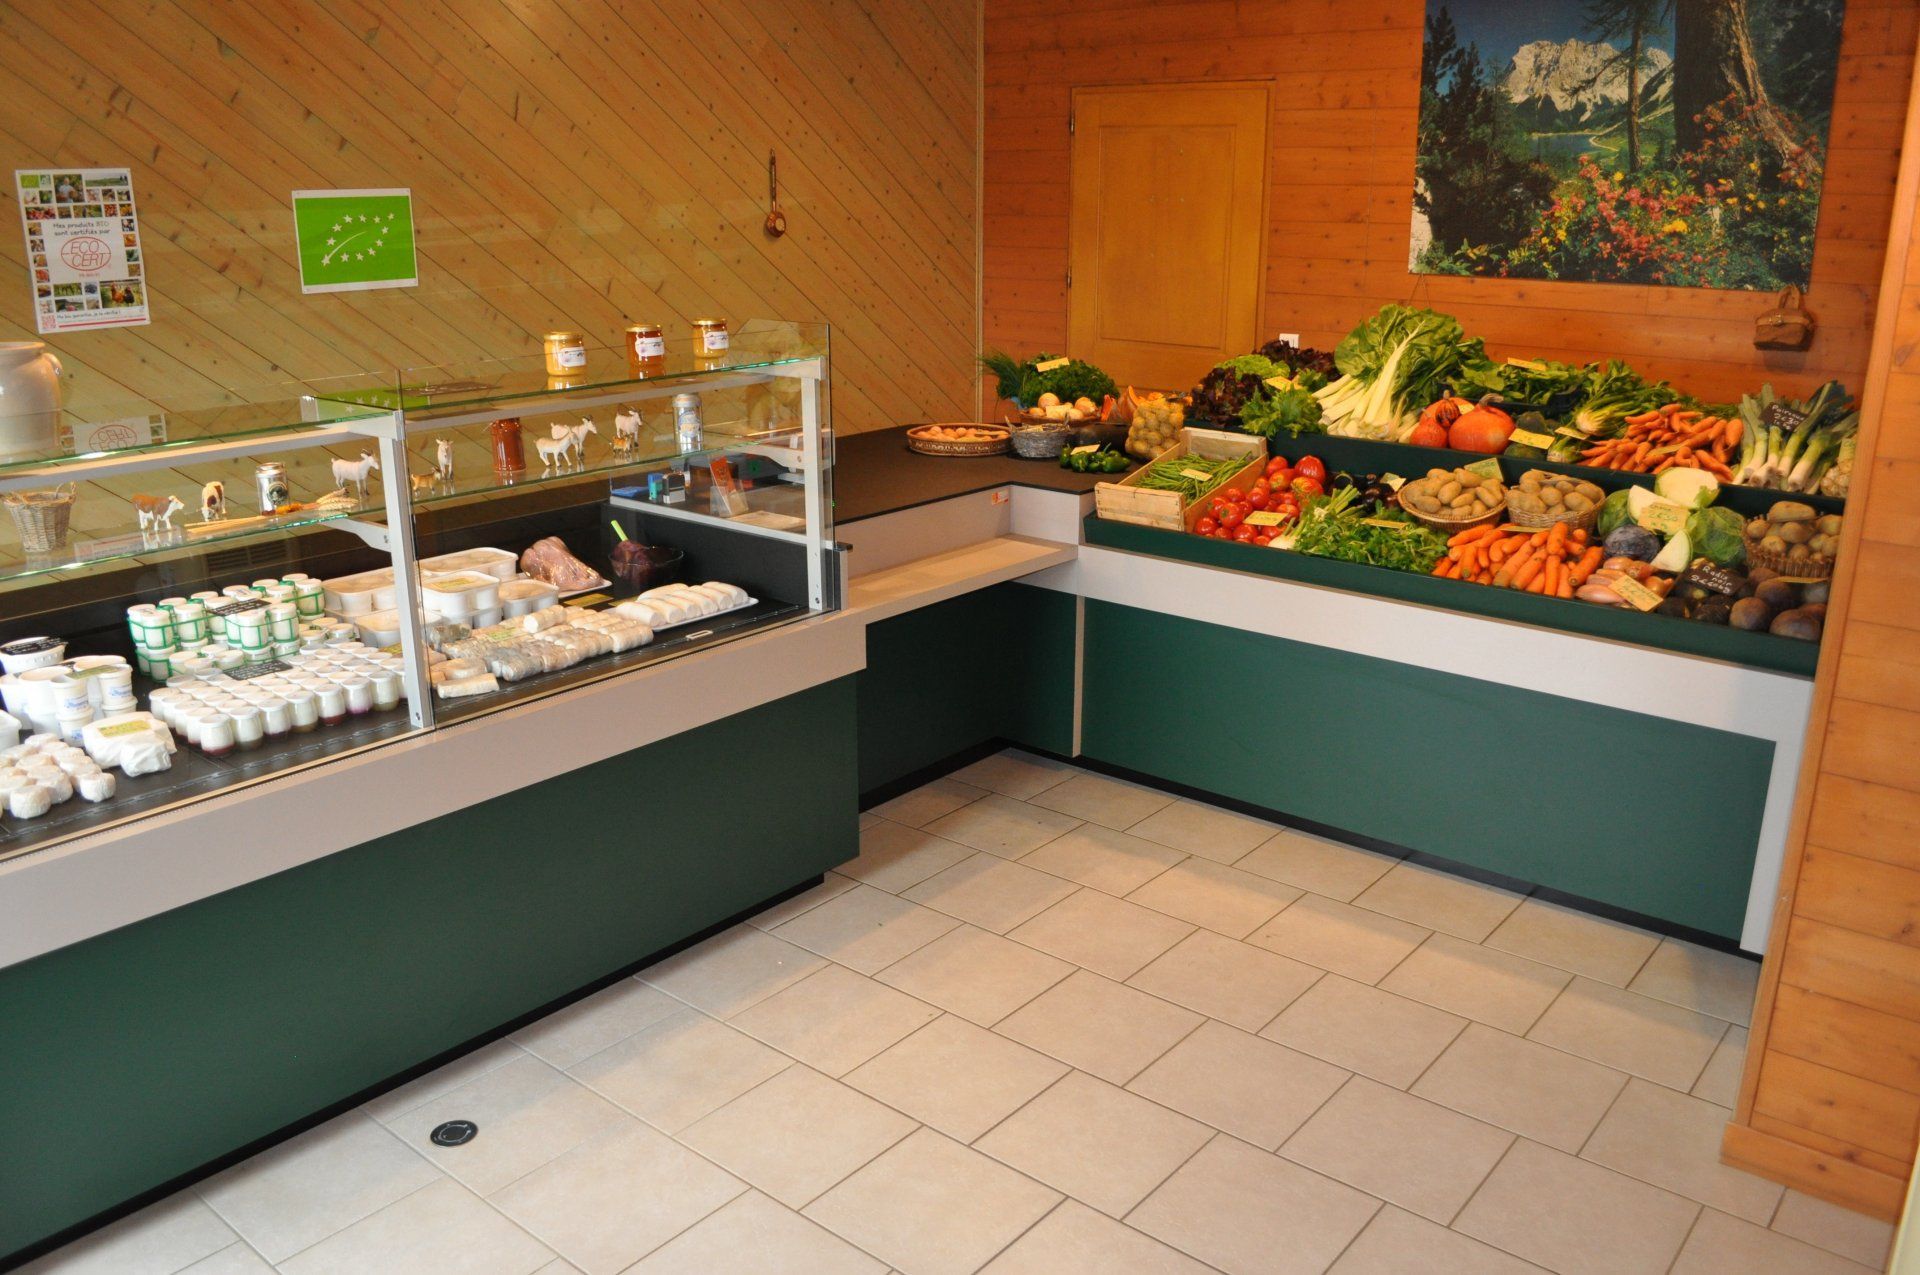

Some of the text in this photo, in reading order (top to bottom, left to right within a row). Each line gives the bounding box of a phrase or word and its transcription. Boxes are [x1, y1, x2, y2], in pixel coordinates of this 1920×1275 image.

[71, 240, 99, 254] ECO
[72, 253, 105, 267] CERT
[1702, 565, 1728, 580] Radis
[1711, 577, 1733, 586] noir
